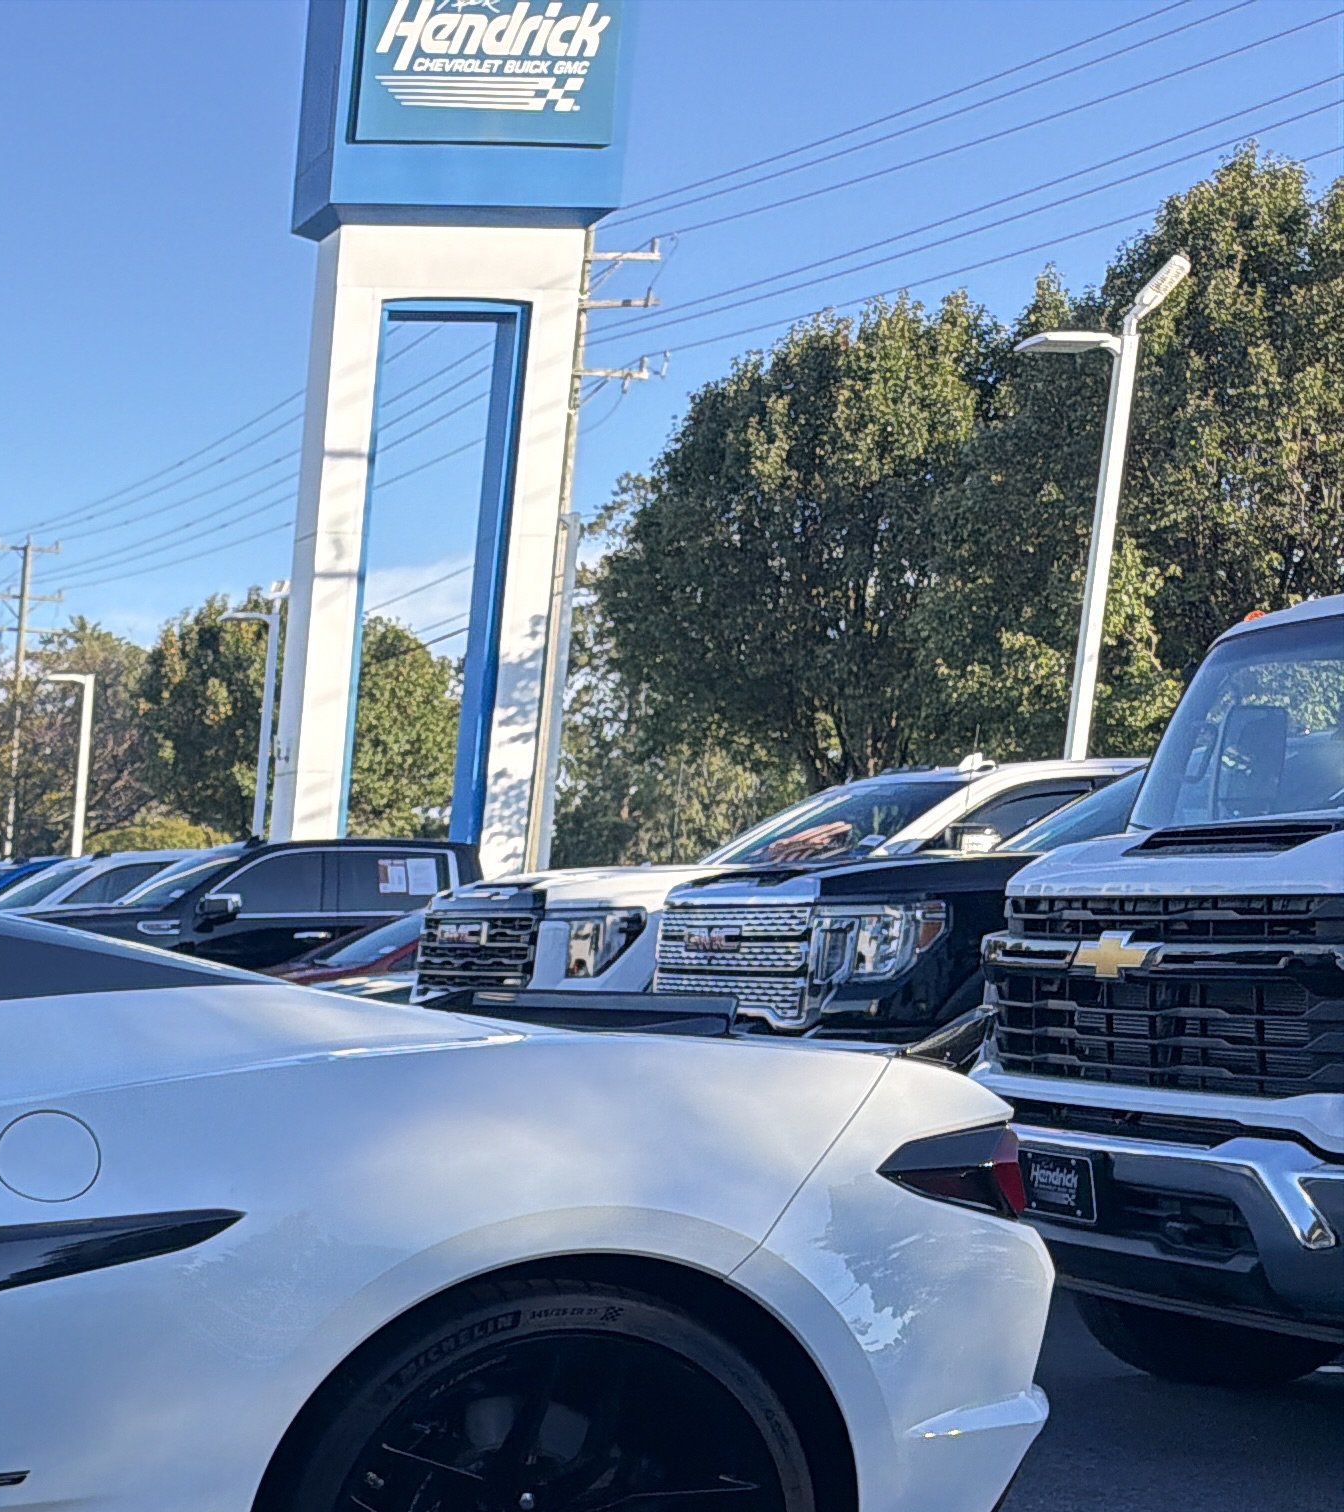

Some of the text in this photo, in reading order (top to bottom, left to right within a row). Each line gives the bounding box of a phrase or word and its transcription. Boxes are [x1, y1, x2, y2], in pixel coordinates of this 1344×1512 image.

[376, 0, 611, 71] Hendrick
[412, 57, 590, 75] CHEVROLET BUICK GMC
[684, 927, 740, 950] GMC
[1030, 1163, 1079, 1189] Hendrick
[398, 1313, 515, 1384] MICHELIN
